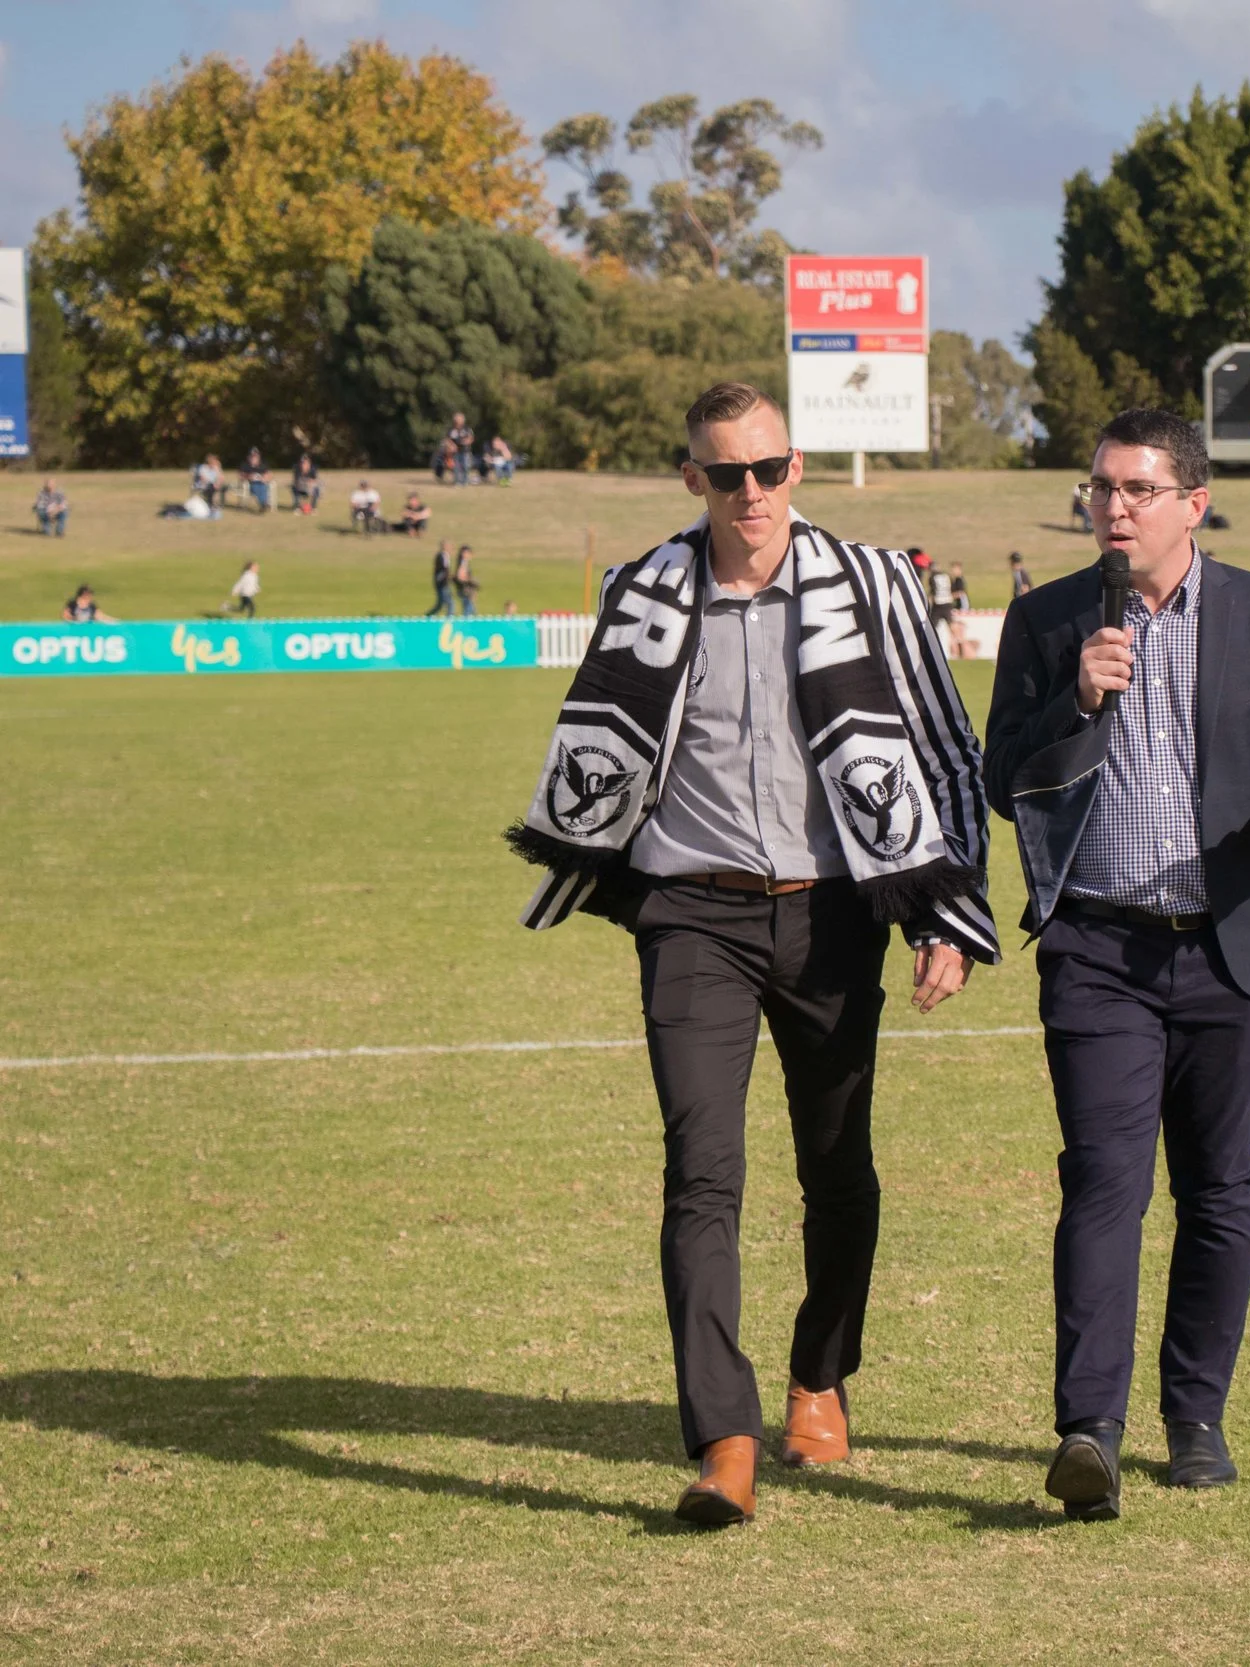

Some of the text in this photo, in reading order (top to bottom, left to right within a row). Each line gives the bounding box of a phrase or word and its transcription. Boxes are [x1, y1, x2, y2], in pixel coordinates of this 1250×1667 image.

[796, 270, 893, 289] REAL ESTATE
[819, 290, 873, 313] Plus
[803, 394, 913, 411] HAINAULT
[12, 623, 242, 673] OPTUS yes
[284, 622, 507, 669] OPTUS yes
[906, 786, 921, 818] FOOTBALL
